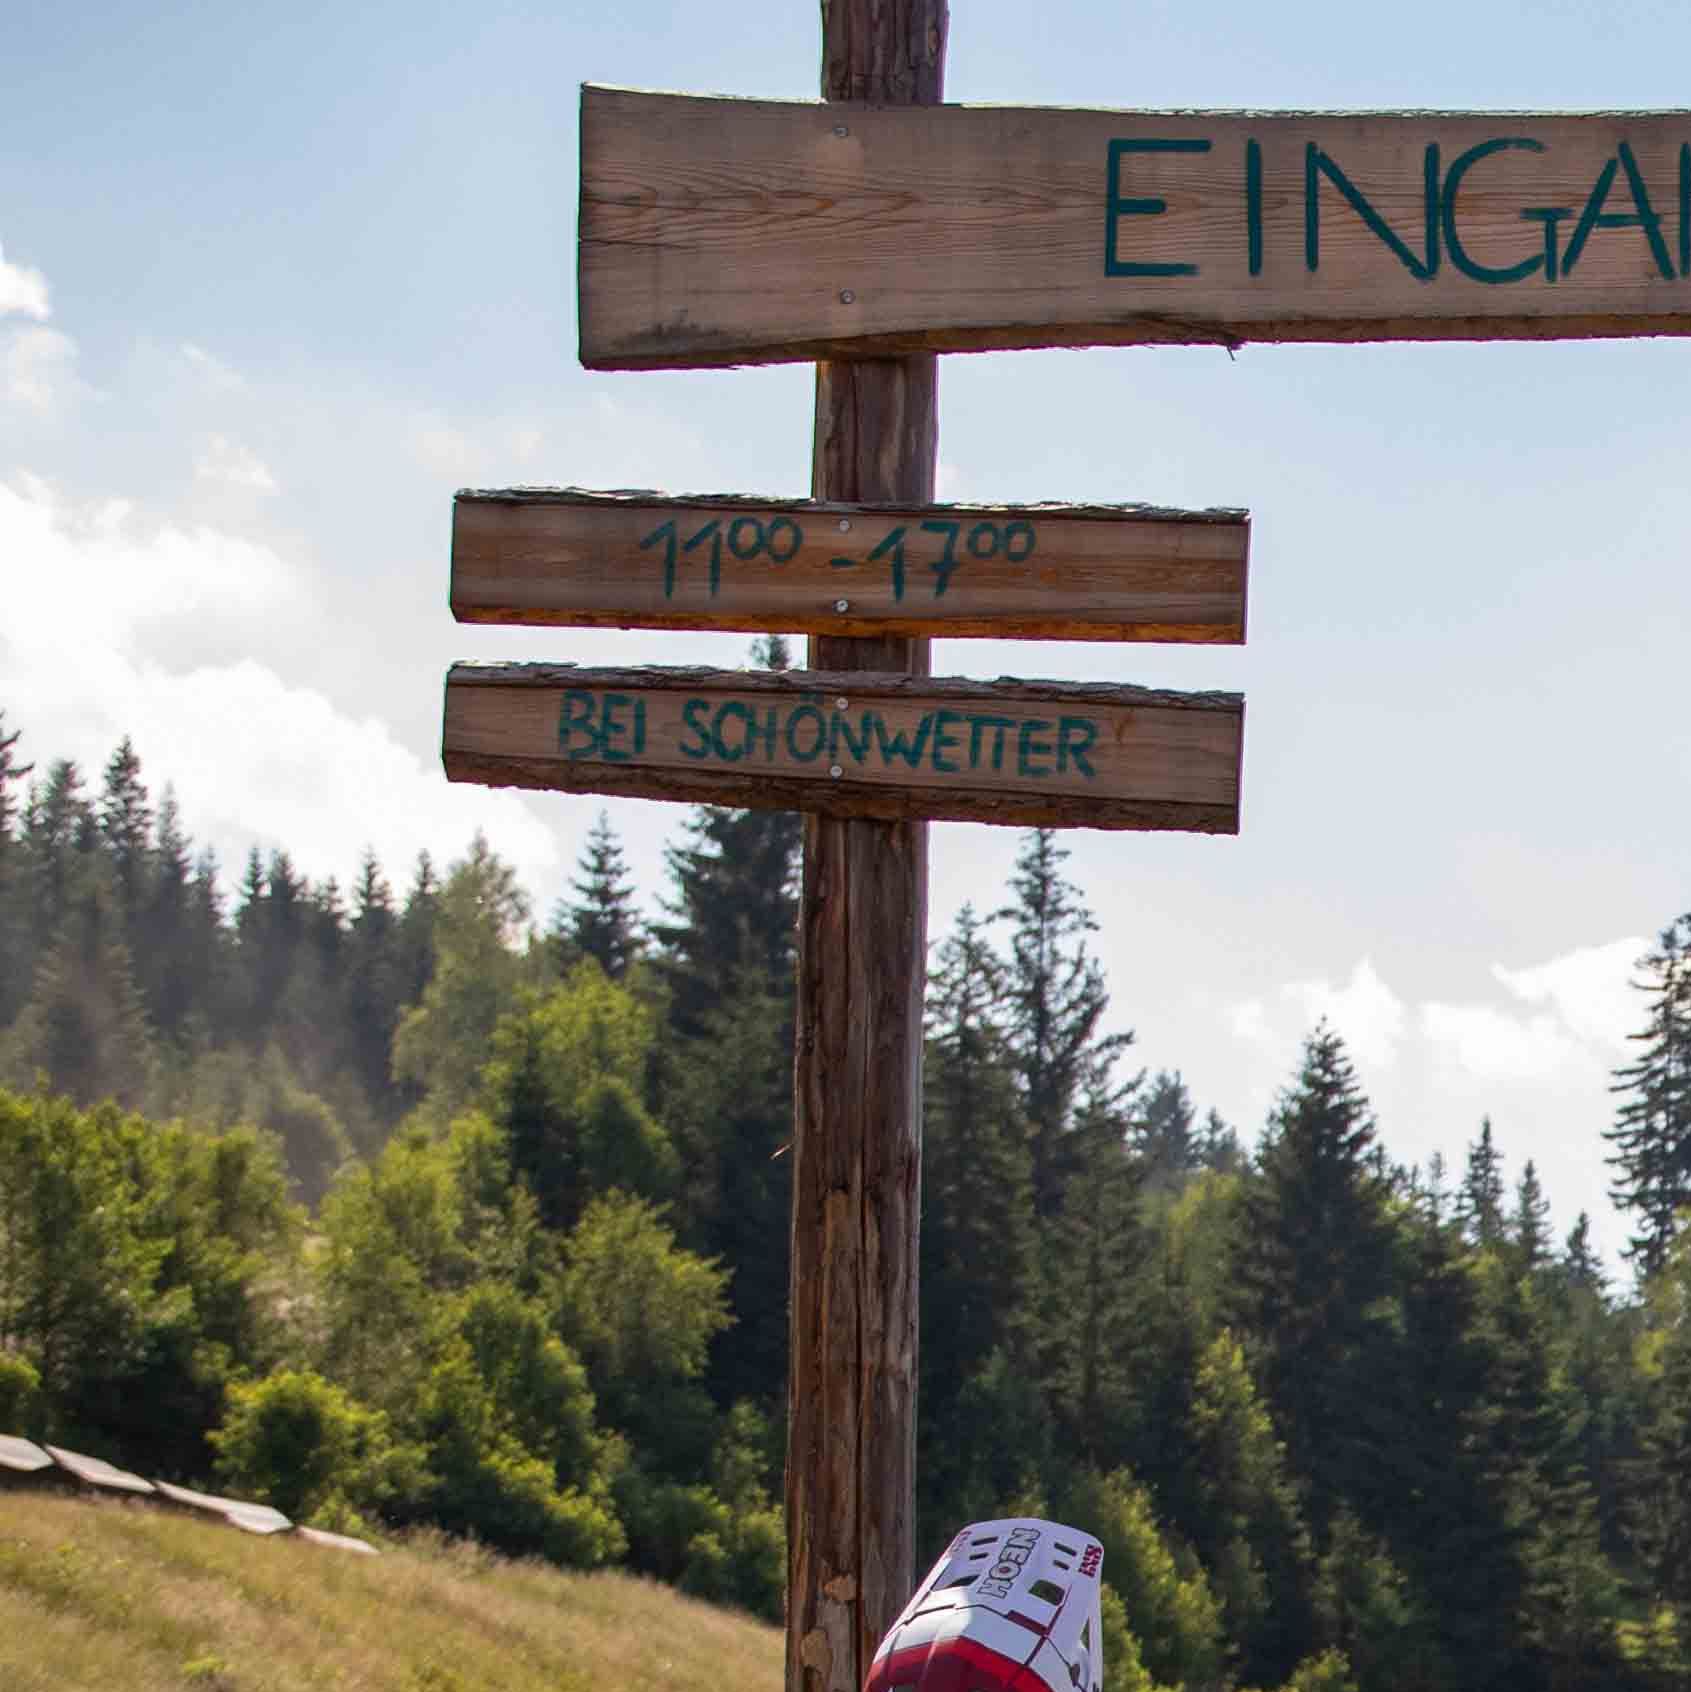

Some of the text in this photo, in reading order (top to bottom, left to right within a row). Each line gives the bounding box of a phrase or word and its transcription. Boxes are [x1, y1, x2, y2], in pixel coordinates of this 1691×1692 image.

[556, 690, 1098, 778] BEI SCHÖNWETTER
[977, 1528, 1041, 1599] NEOH
